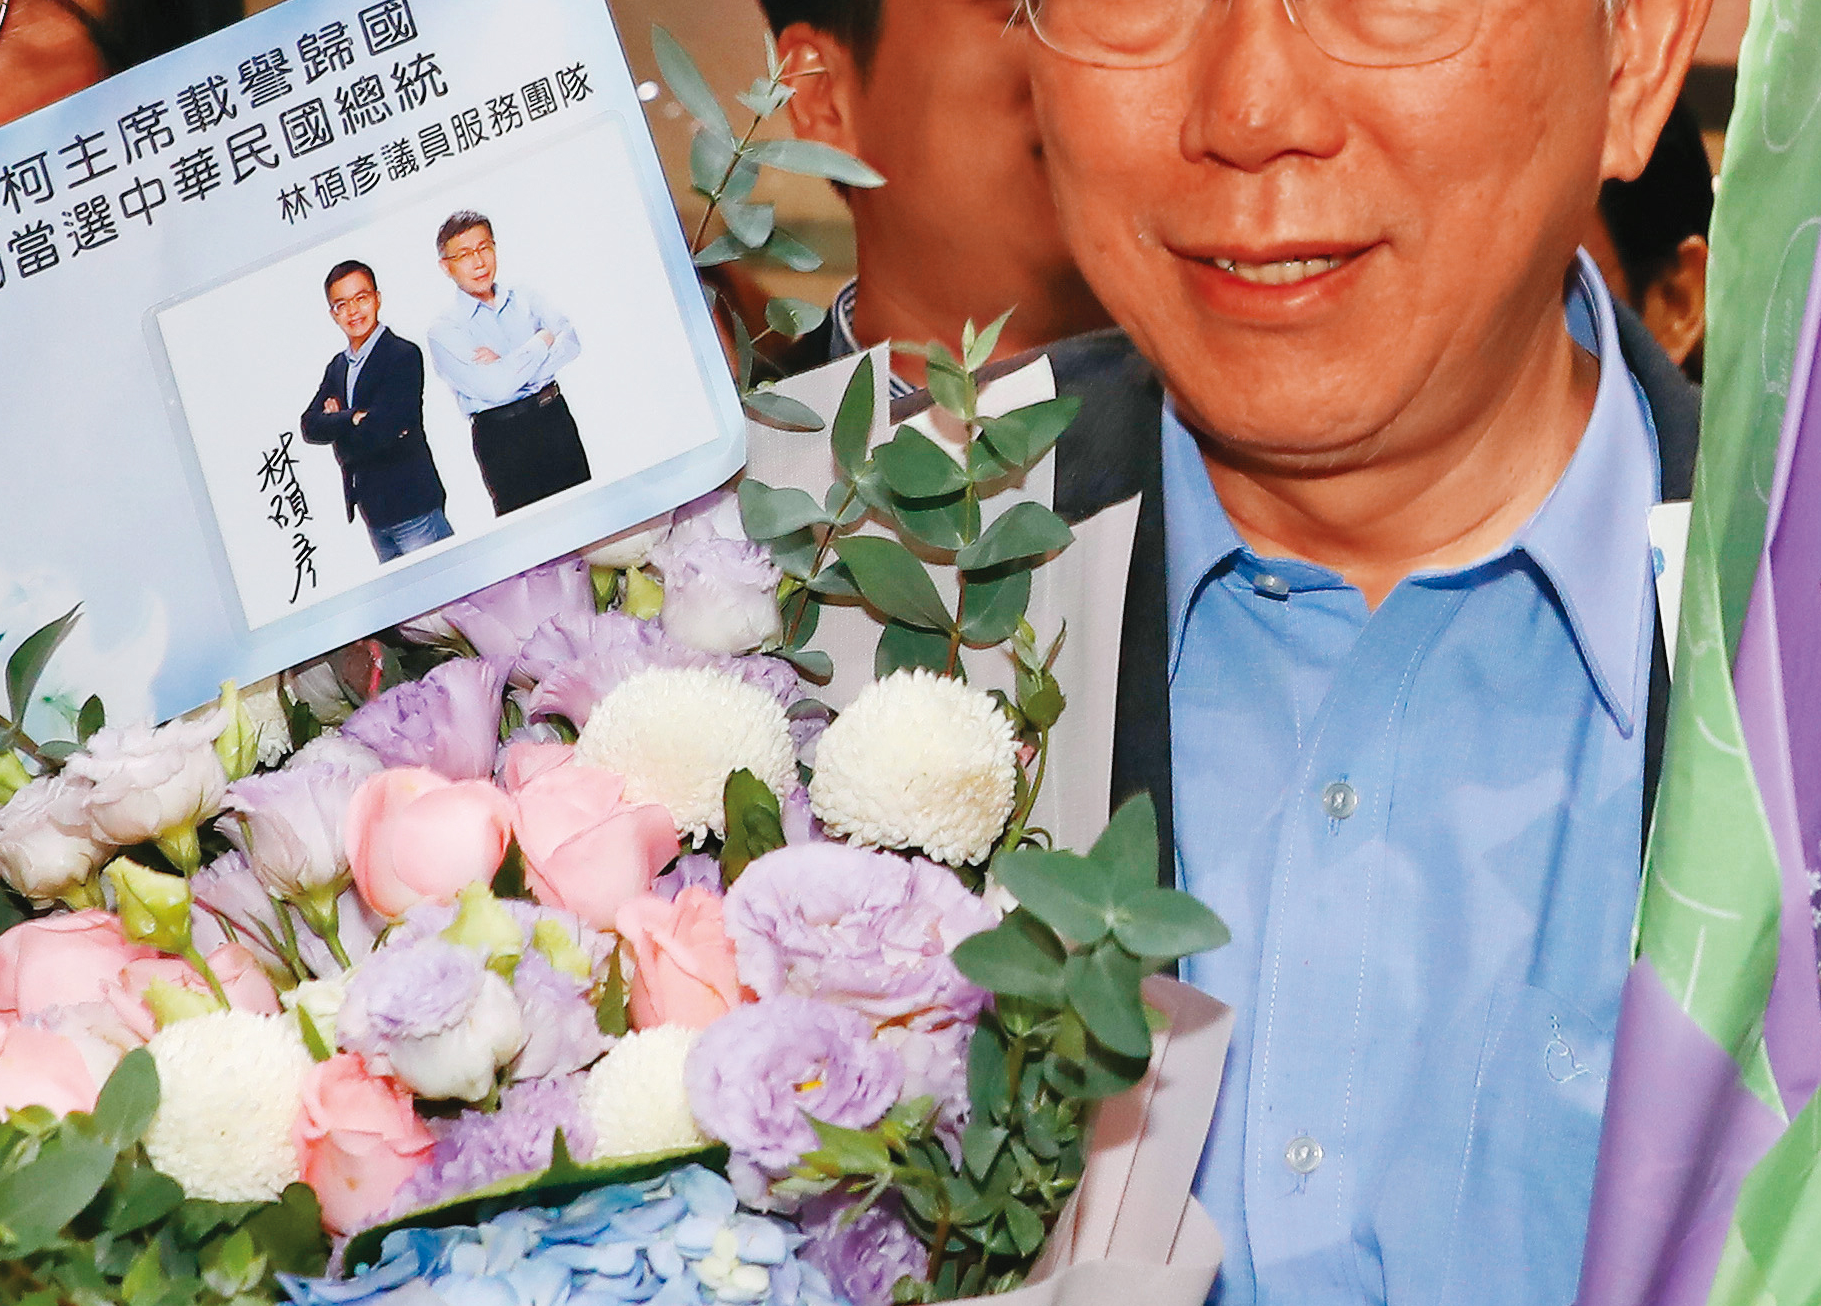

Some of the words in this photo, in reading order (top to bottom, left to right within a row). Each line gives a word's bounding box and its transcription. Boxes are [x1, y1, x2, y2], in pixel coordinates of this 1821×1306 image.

[276, 61, 595, 226] 林碩彥議員服務團隊
